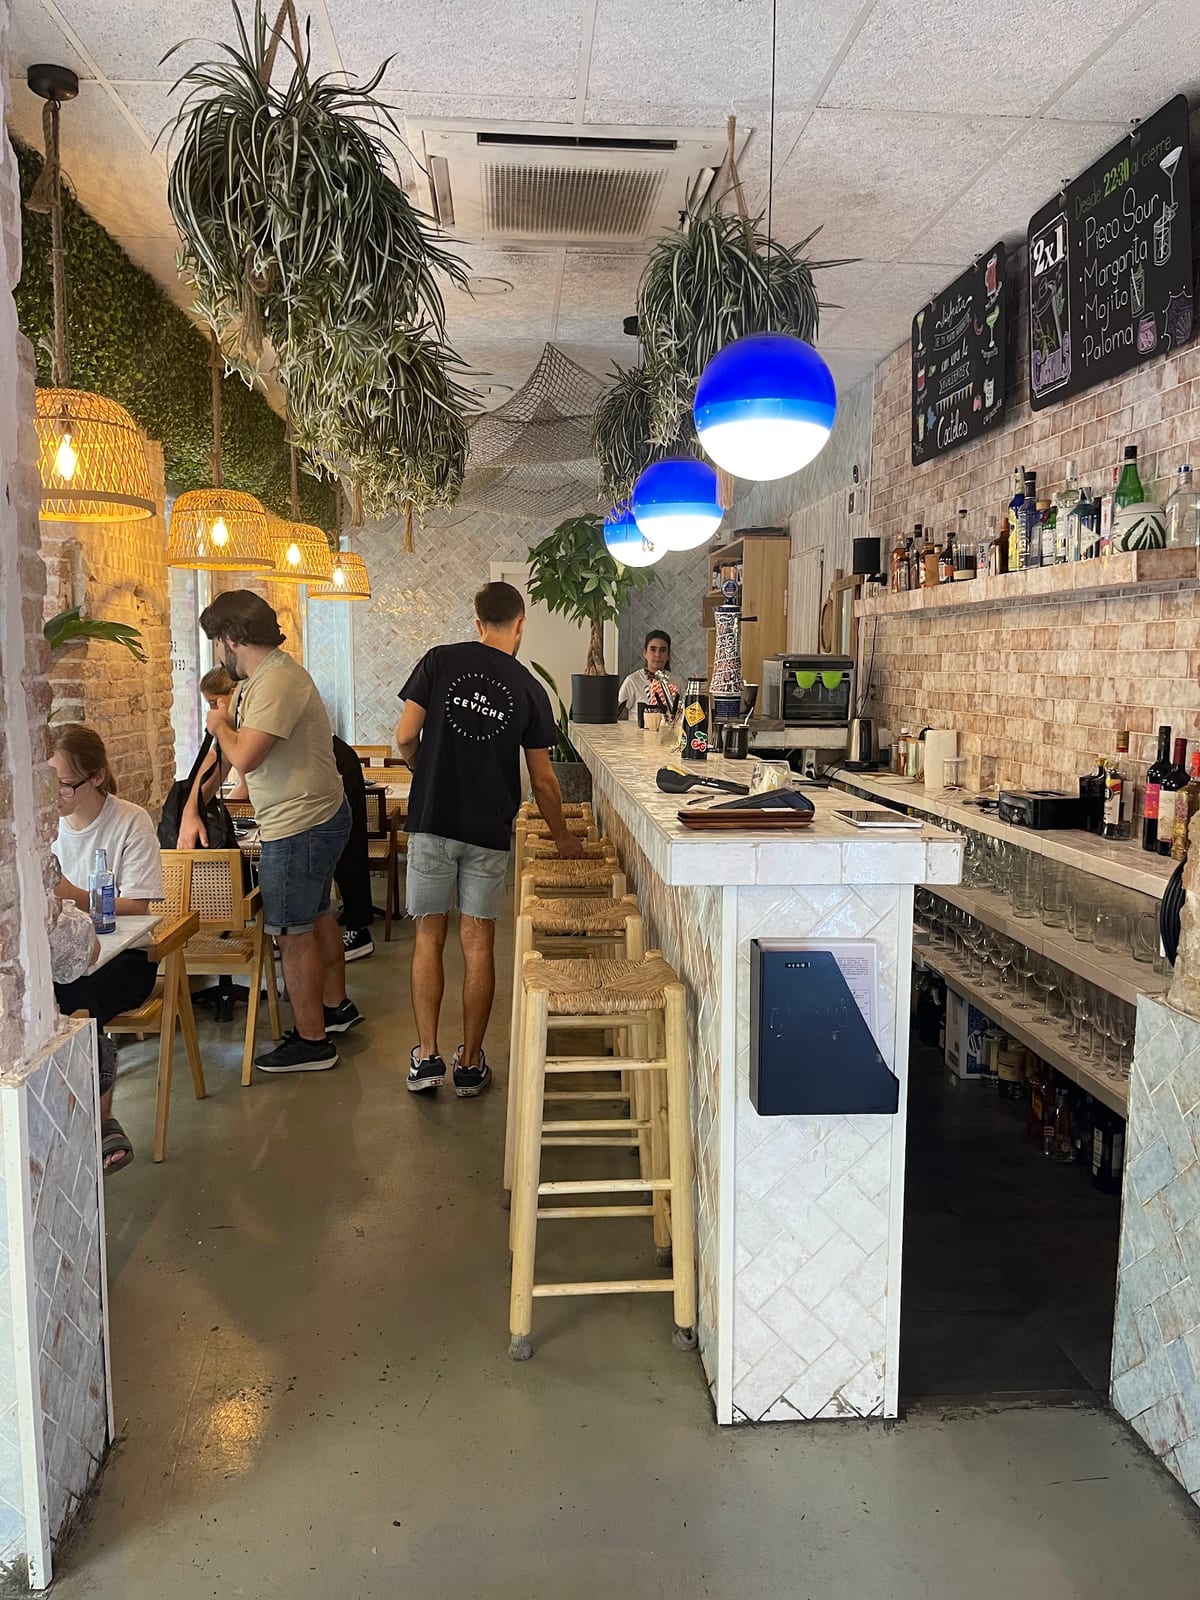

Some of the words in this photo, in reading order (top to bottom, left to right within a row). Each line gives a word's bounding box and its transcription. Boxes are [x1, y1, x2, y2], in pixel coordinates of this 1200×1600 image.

[1074, 180, 1102, 221] Desde
[1085, 216, 1120, 258] Pisco
[1123, 187, 1160, 233] Sour
[1033, 224, 1066, 277] 2x1
[1084, 233, 1148, 297] Margarita
[1085, 287, 1128, 332] Mojito
[1083, 323, 1134, 367] Paloma
[453, 697, 505, 721] CEVICHE
[473, 692, 491, 706] SR.
